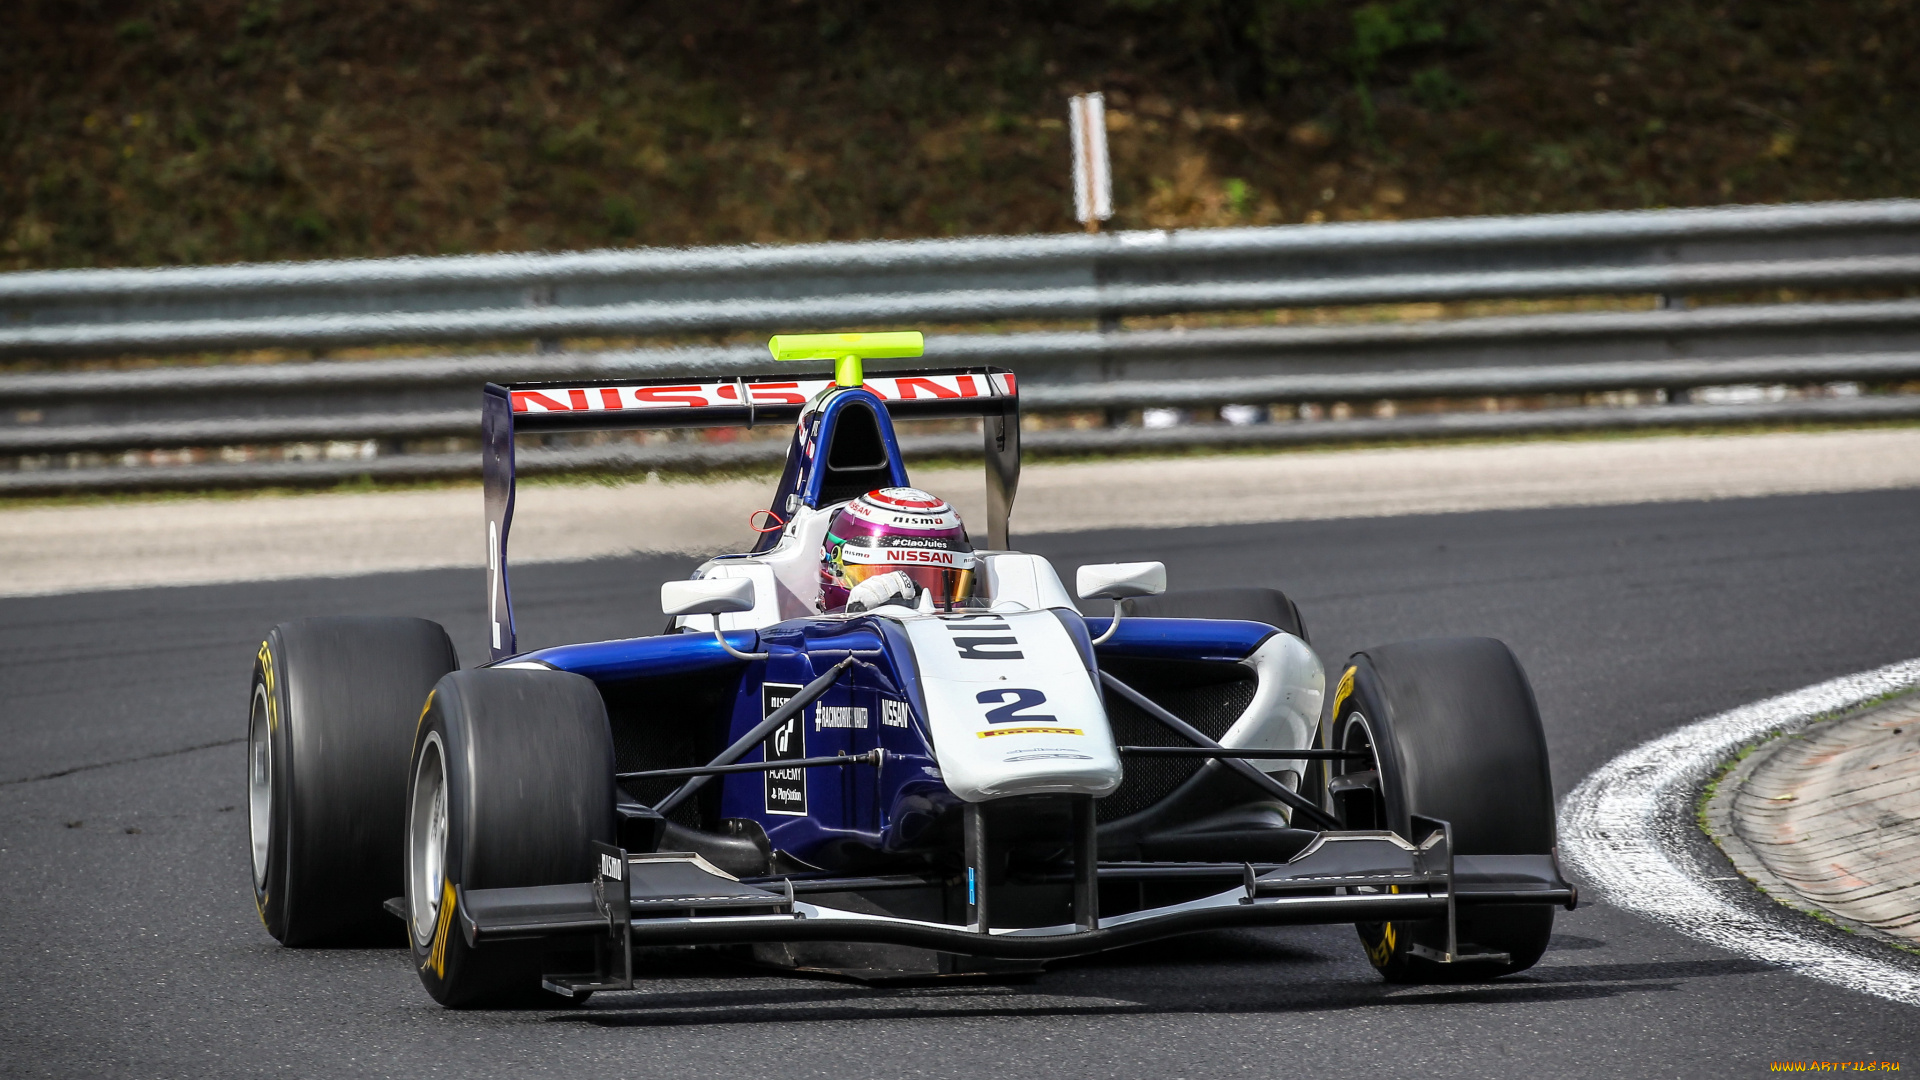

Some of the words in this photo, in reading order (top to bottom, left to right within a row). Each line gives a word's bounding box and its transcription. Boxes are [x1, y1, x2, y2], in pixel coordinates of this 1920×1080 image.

[892, 539, 948, 549] #CiaoJules
[886, 550, 953, 564] NISSAN
[882, 699, 909, 729] NISSAN
[976, 688, 1058, 725] 2
[778, 787, 802, 804] PlayStation
